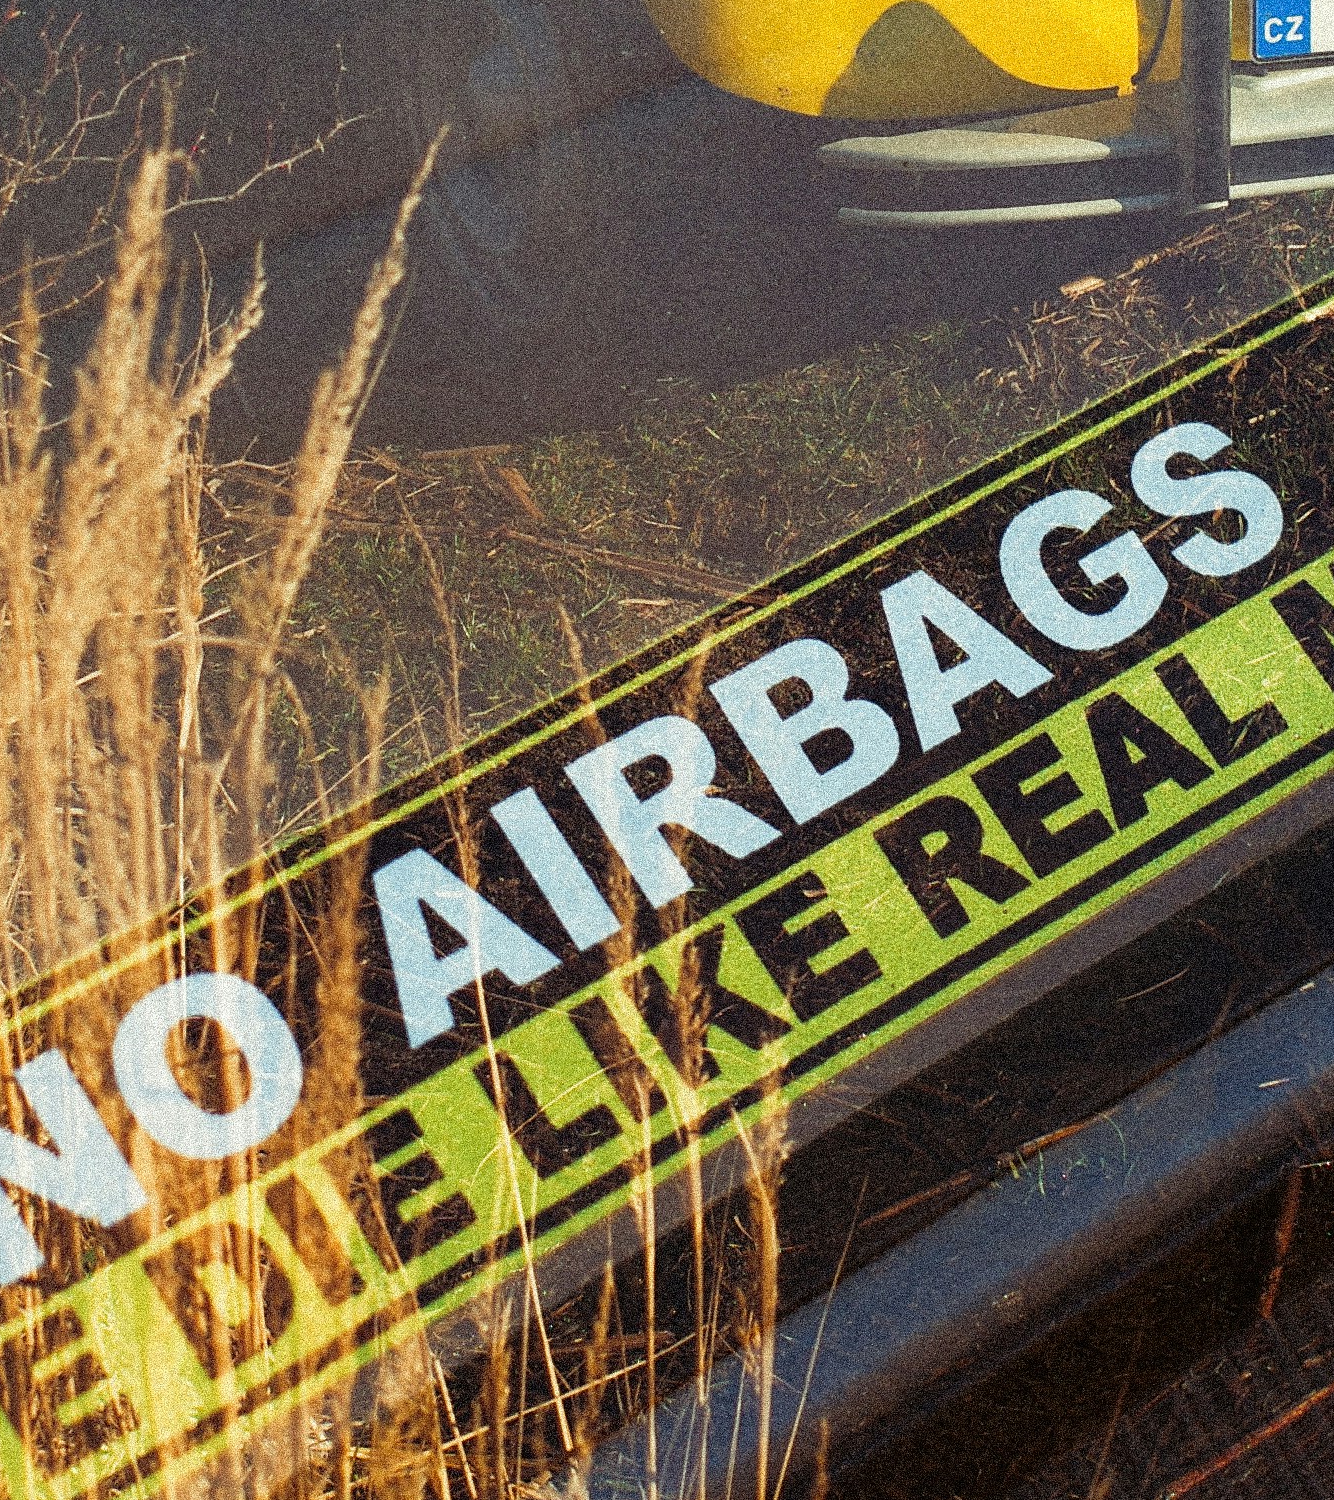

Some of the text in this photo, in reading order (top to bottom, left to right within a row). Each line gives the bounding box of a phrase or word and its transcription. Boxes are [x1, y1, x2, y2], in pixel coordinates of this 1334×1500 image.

[1264, 15, 1304, 42] CZ
[154, 1106, 479, 1386] DIE
[473, 871, 880, 1178] LIKE
[873, 653, 1287, 938] REAL
[370, 421, 1282, 1049] AIRBAGS
